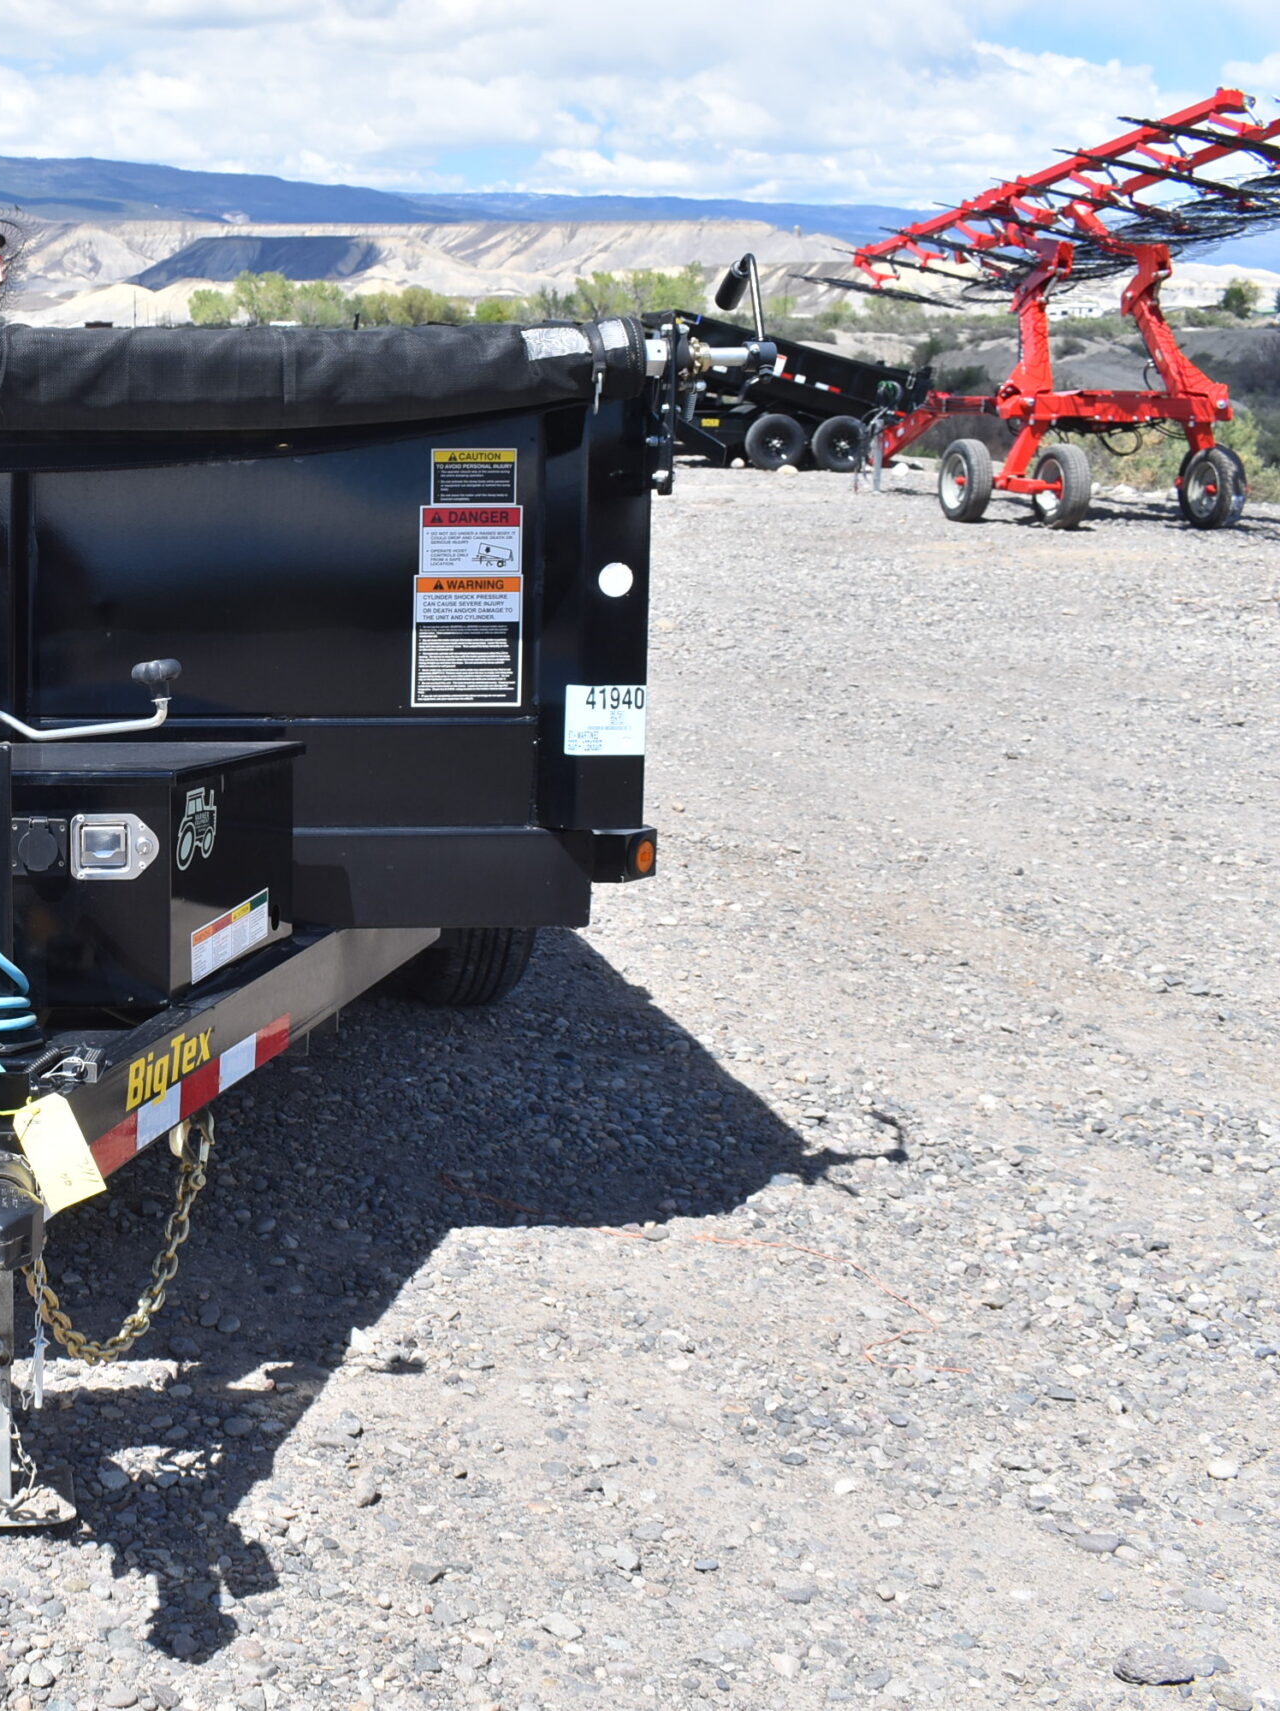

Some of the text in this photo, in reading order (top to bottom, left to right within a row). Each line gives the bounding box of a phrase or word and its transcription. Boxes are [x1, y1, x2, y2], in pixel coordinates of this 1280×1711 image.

[458, 452, 501, 461] CAUTION
[448, 512, 510, 523] DANGER
[447, 580, 504, 590] WARNING
[586, 687, 644, 709] 41940
[126, 1026, 213, 1112] BigTex
